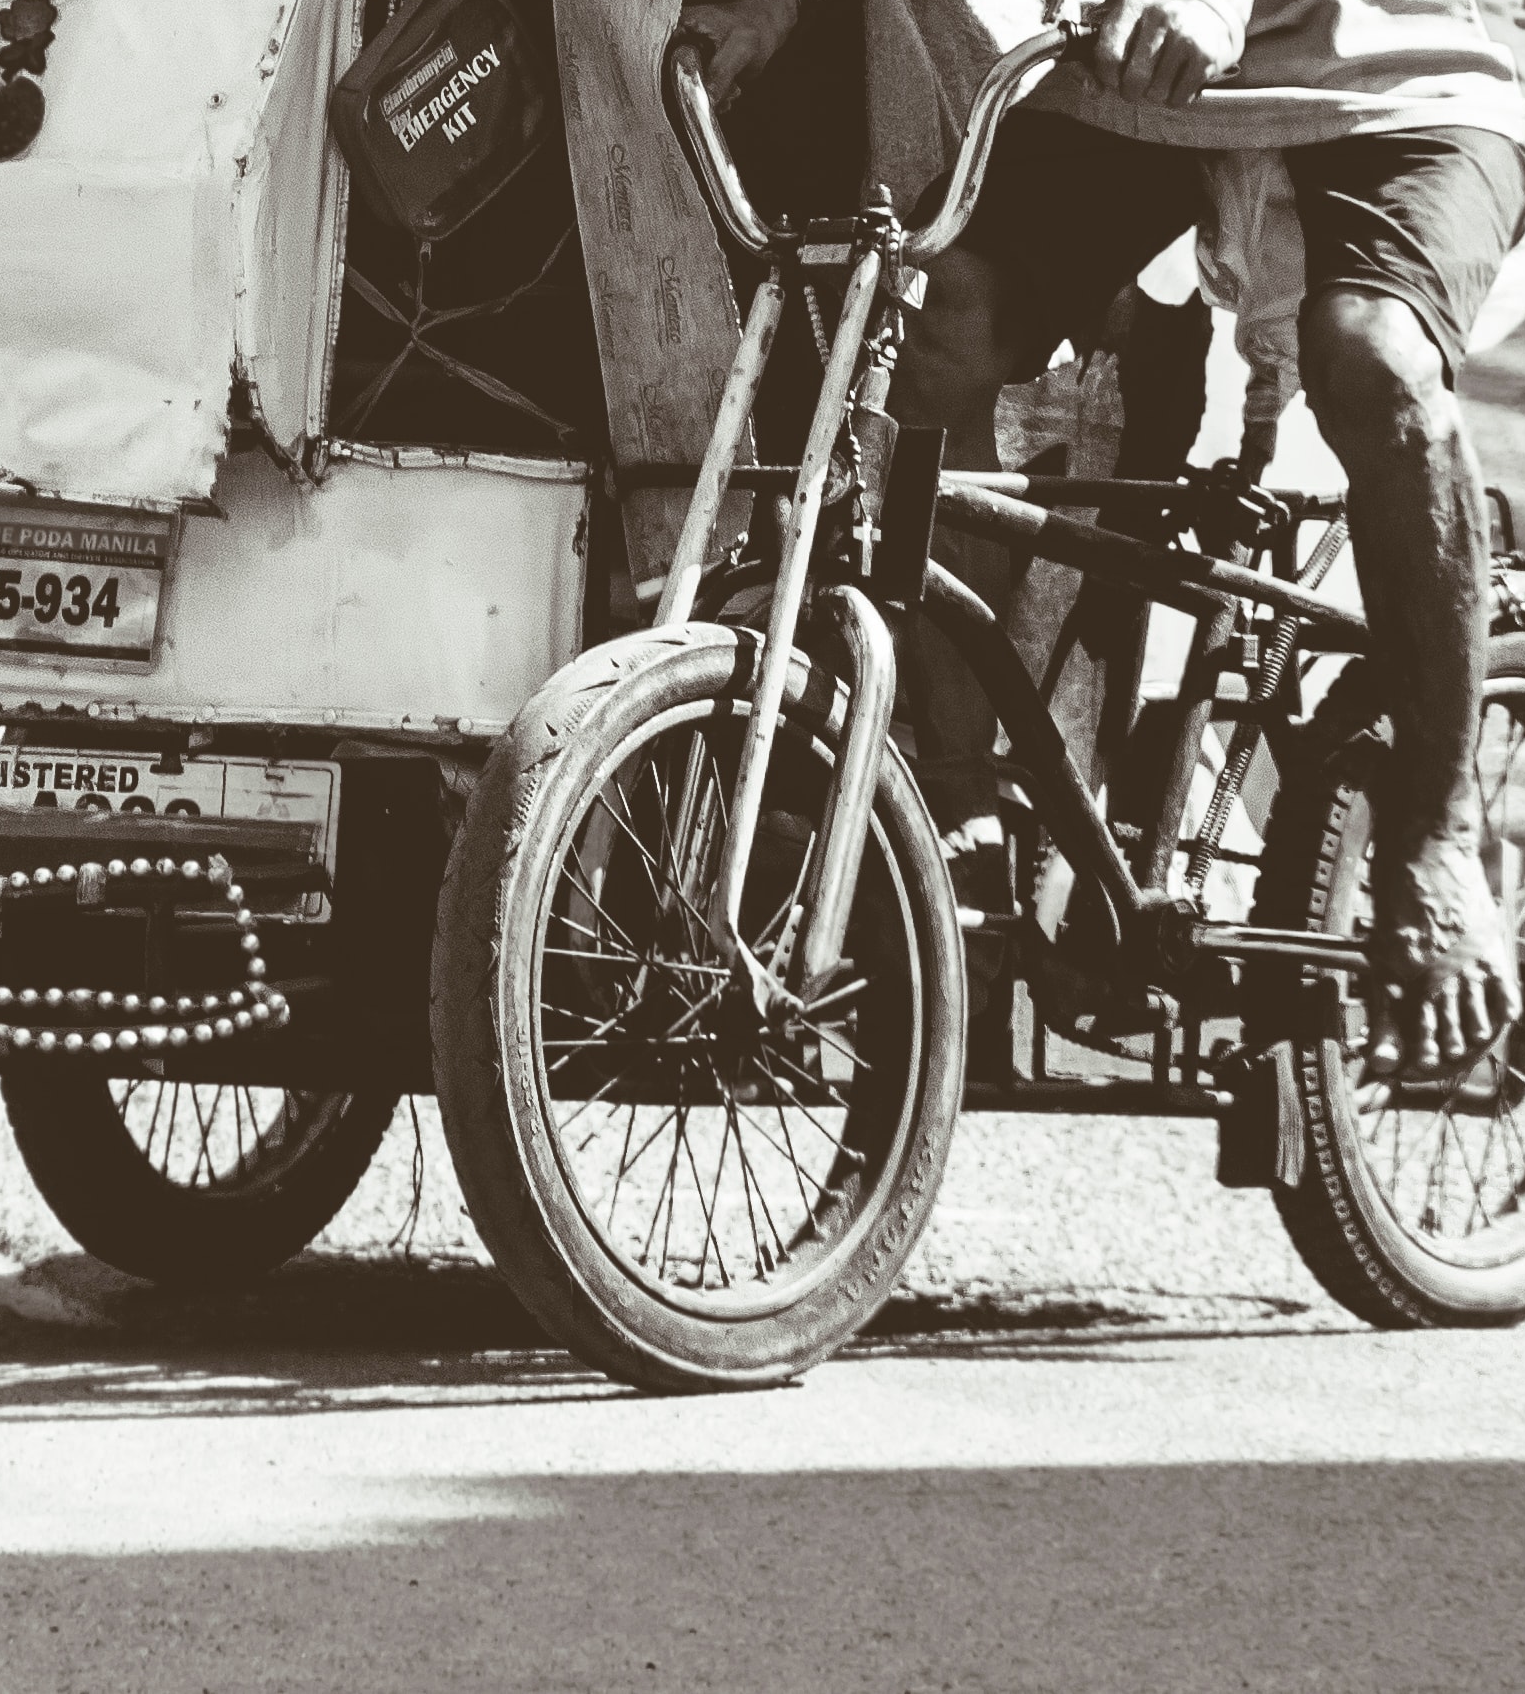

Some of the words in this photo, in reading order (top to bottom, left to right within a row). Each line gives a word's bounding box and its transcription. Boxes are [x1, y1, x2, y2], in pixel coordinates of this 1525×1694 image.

[398, 44, 500, 152] EMERGENCY
[442, 102, 476, 144] KIT
[19, 527, 73, 549] PODA
[79, 532, 157, 555] MANILA
